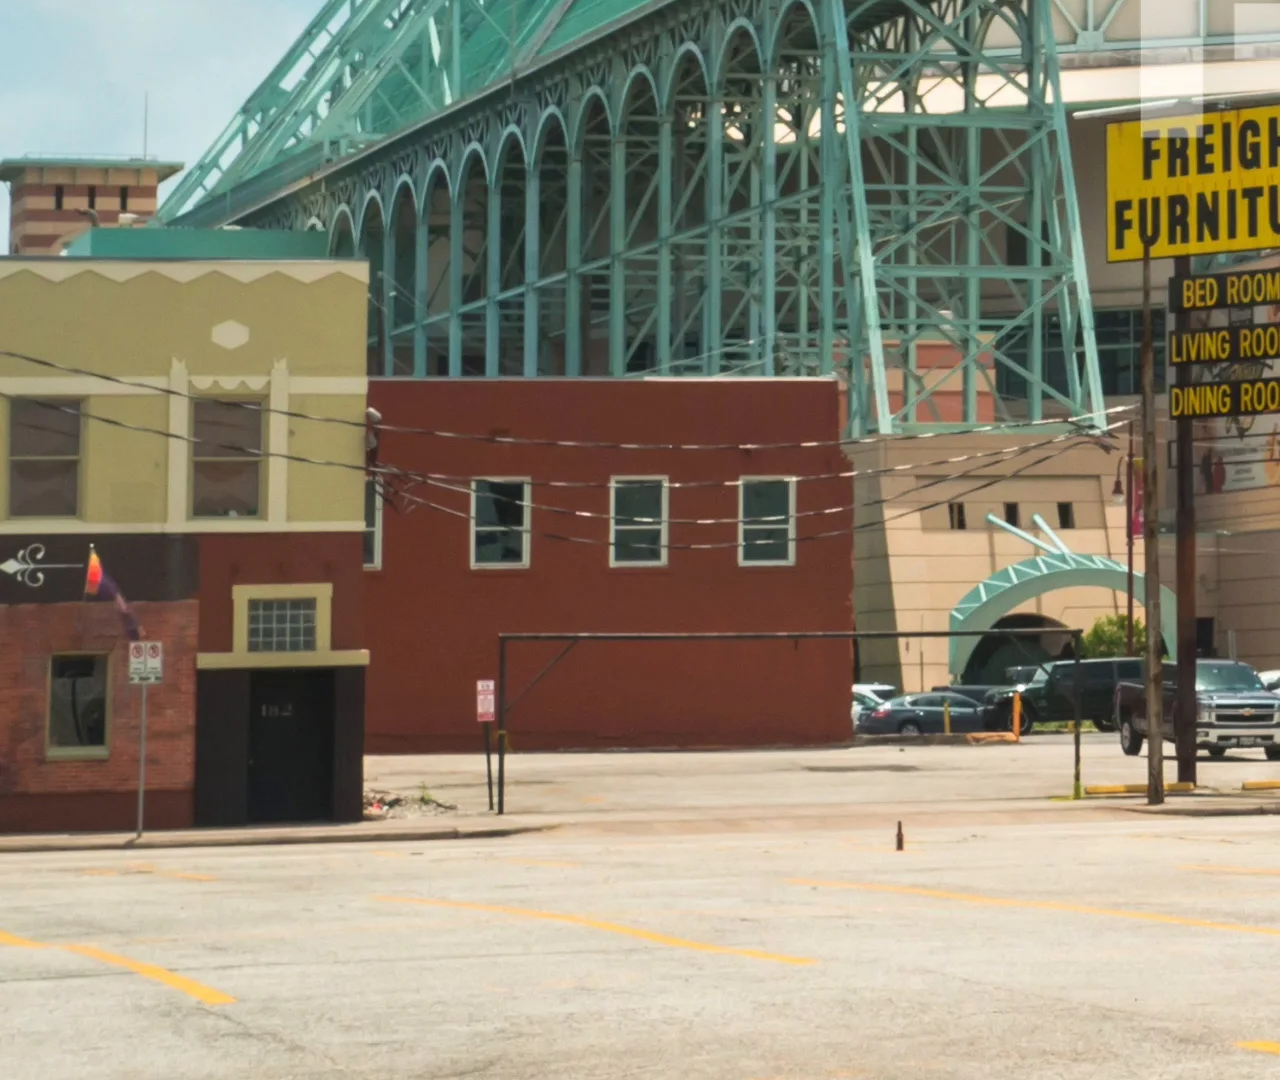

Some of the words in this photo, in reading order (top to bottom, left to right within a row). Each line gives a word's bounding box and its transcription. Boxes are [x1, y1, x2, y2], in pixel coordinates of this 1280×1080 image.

[1183, 278, 1219, 308] BED
[1227, 272, 1280, 304] ROOM
[1172, 331, 1231, 363] LIVING
[1171, 384, 1232, 416] DINING
